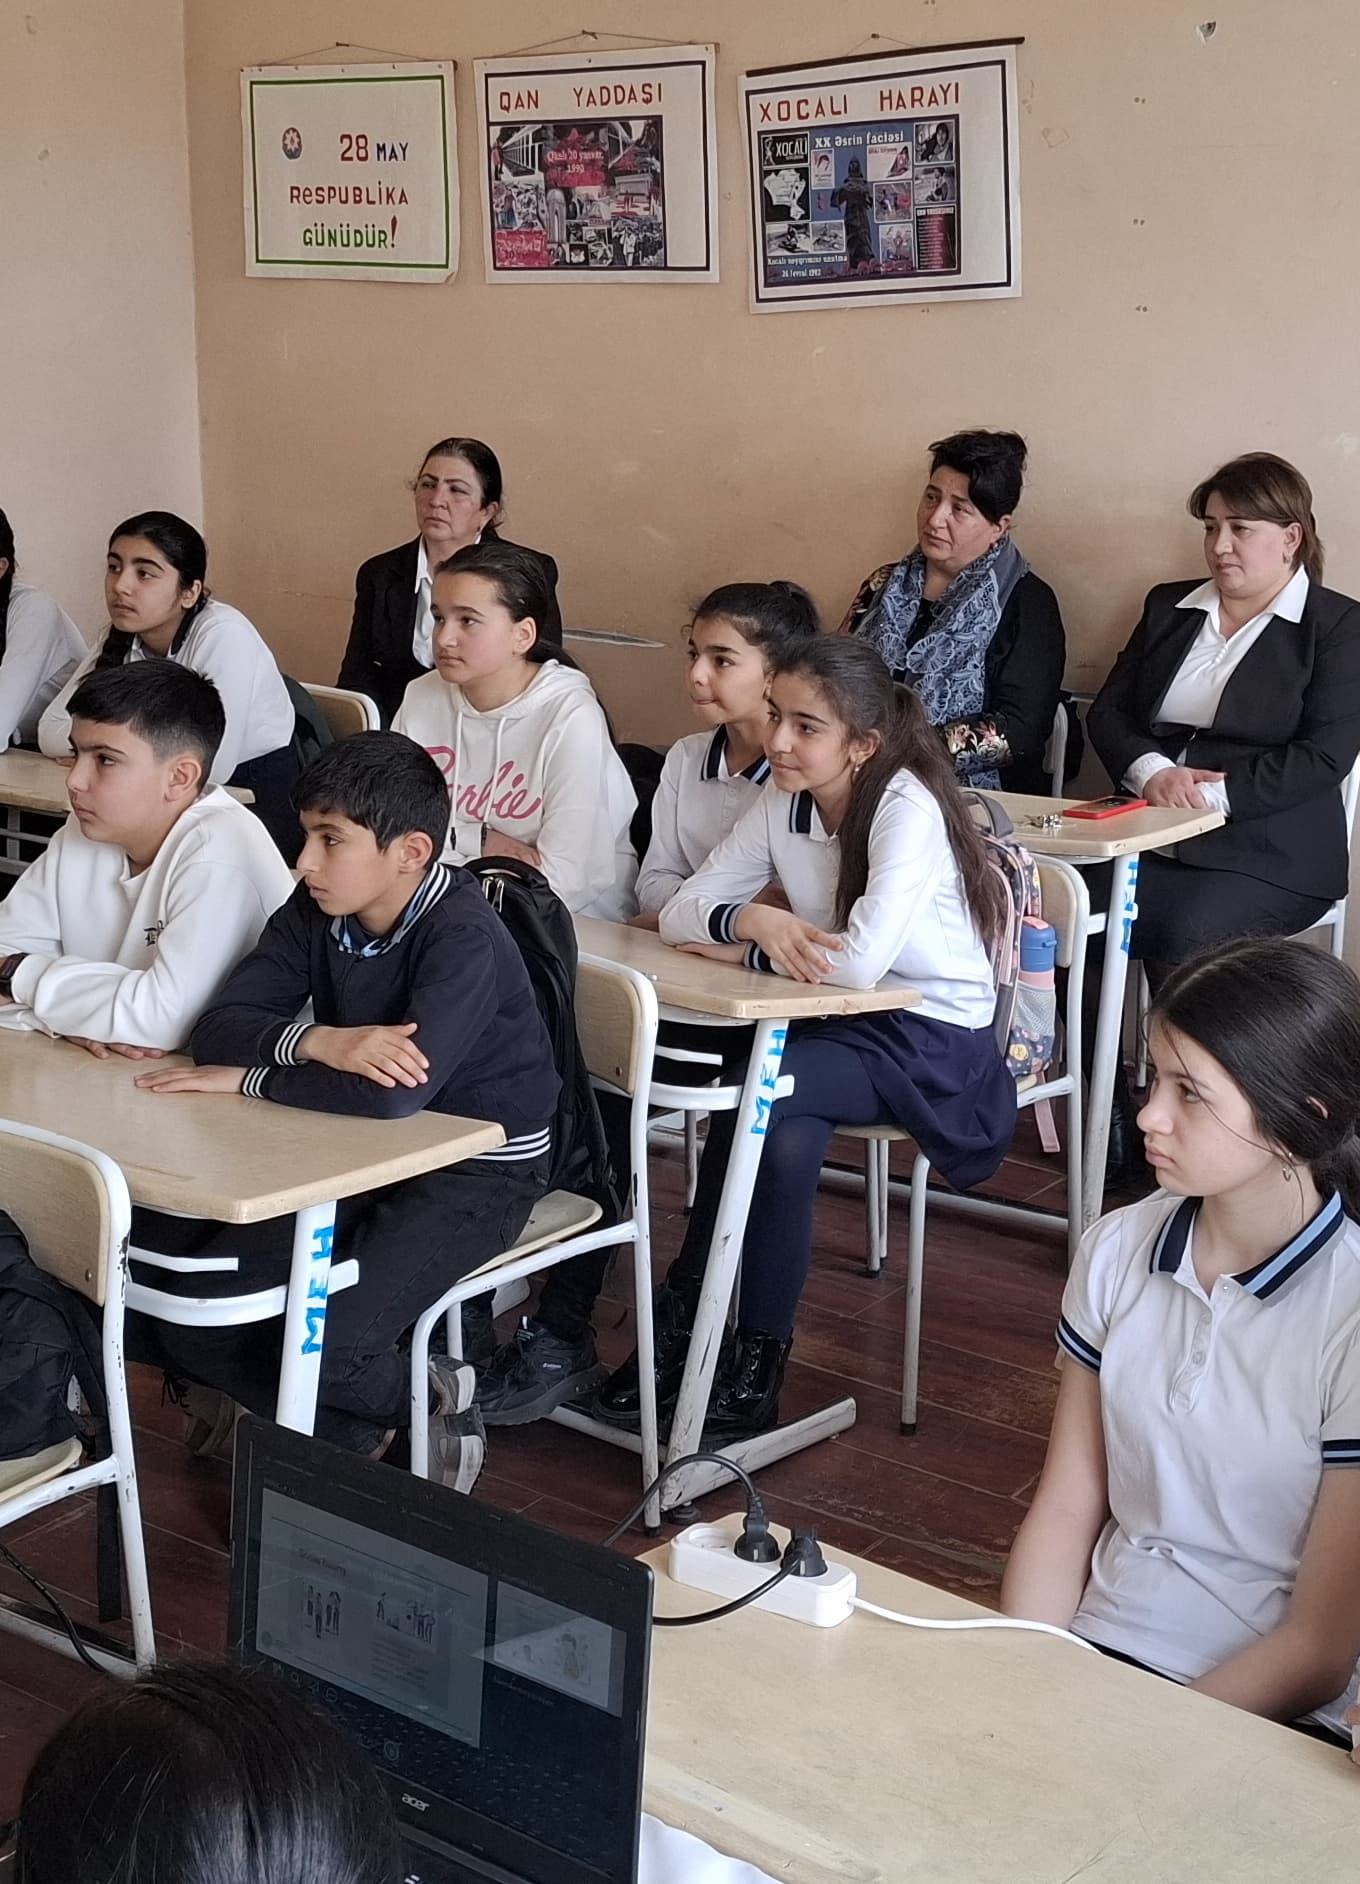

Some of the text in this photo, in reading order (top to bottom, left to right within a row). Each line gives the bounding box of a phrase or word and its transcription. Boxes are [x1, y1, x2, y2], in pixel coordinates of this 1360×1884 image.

[499, 82, 663, 113] QAN YADDAŞI
[759, 82, 960, 123] XOCALI HARAYI
[339, 133, 409, 163] 28 MAY
[775, 138, 808, 158] XOCALI
[815, 137, 831, 148] XX
[834, 134, 863, 147] Əsrin
[302, 215, 399, 250] GÜNÜDÜR!
[750, 1027, 787, 1135] MEH
[300, 1225, 335, 1356] MEH
[402, 1793, 430, 1812] acer
